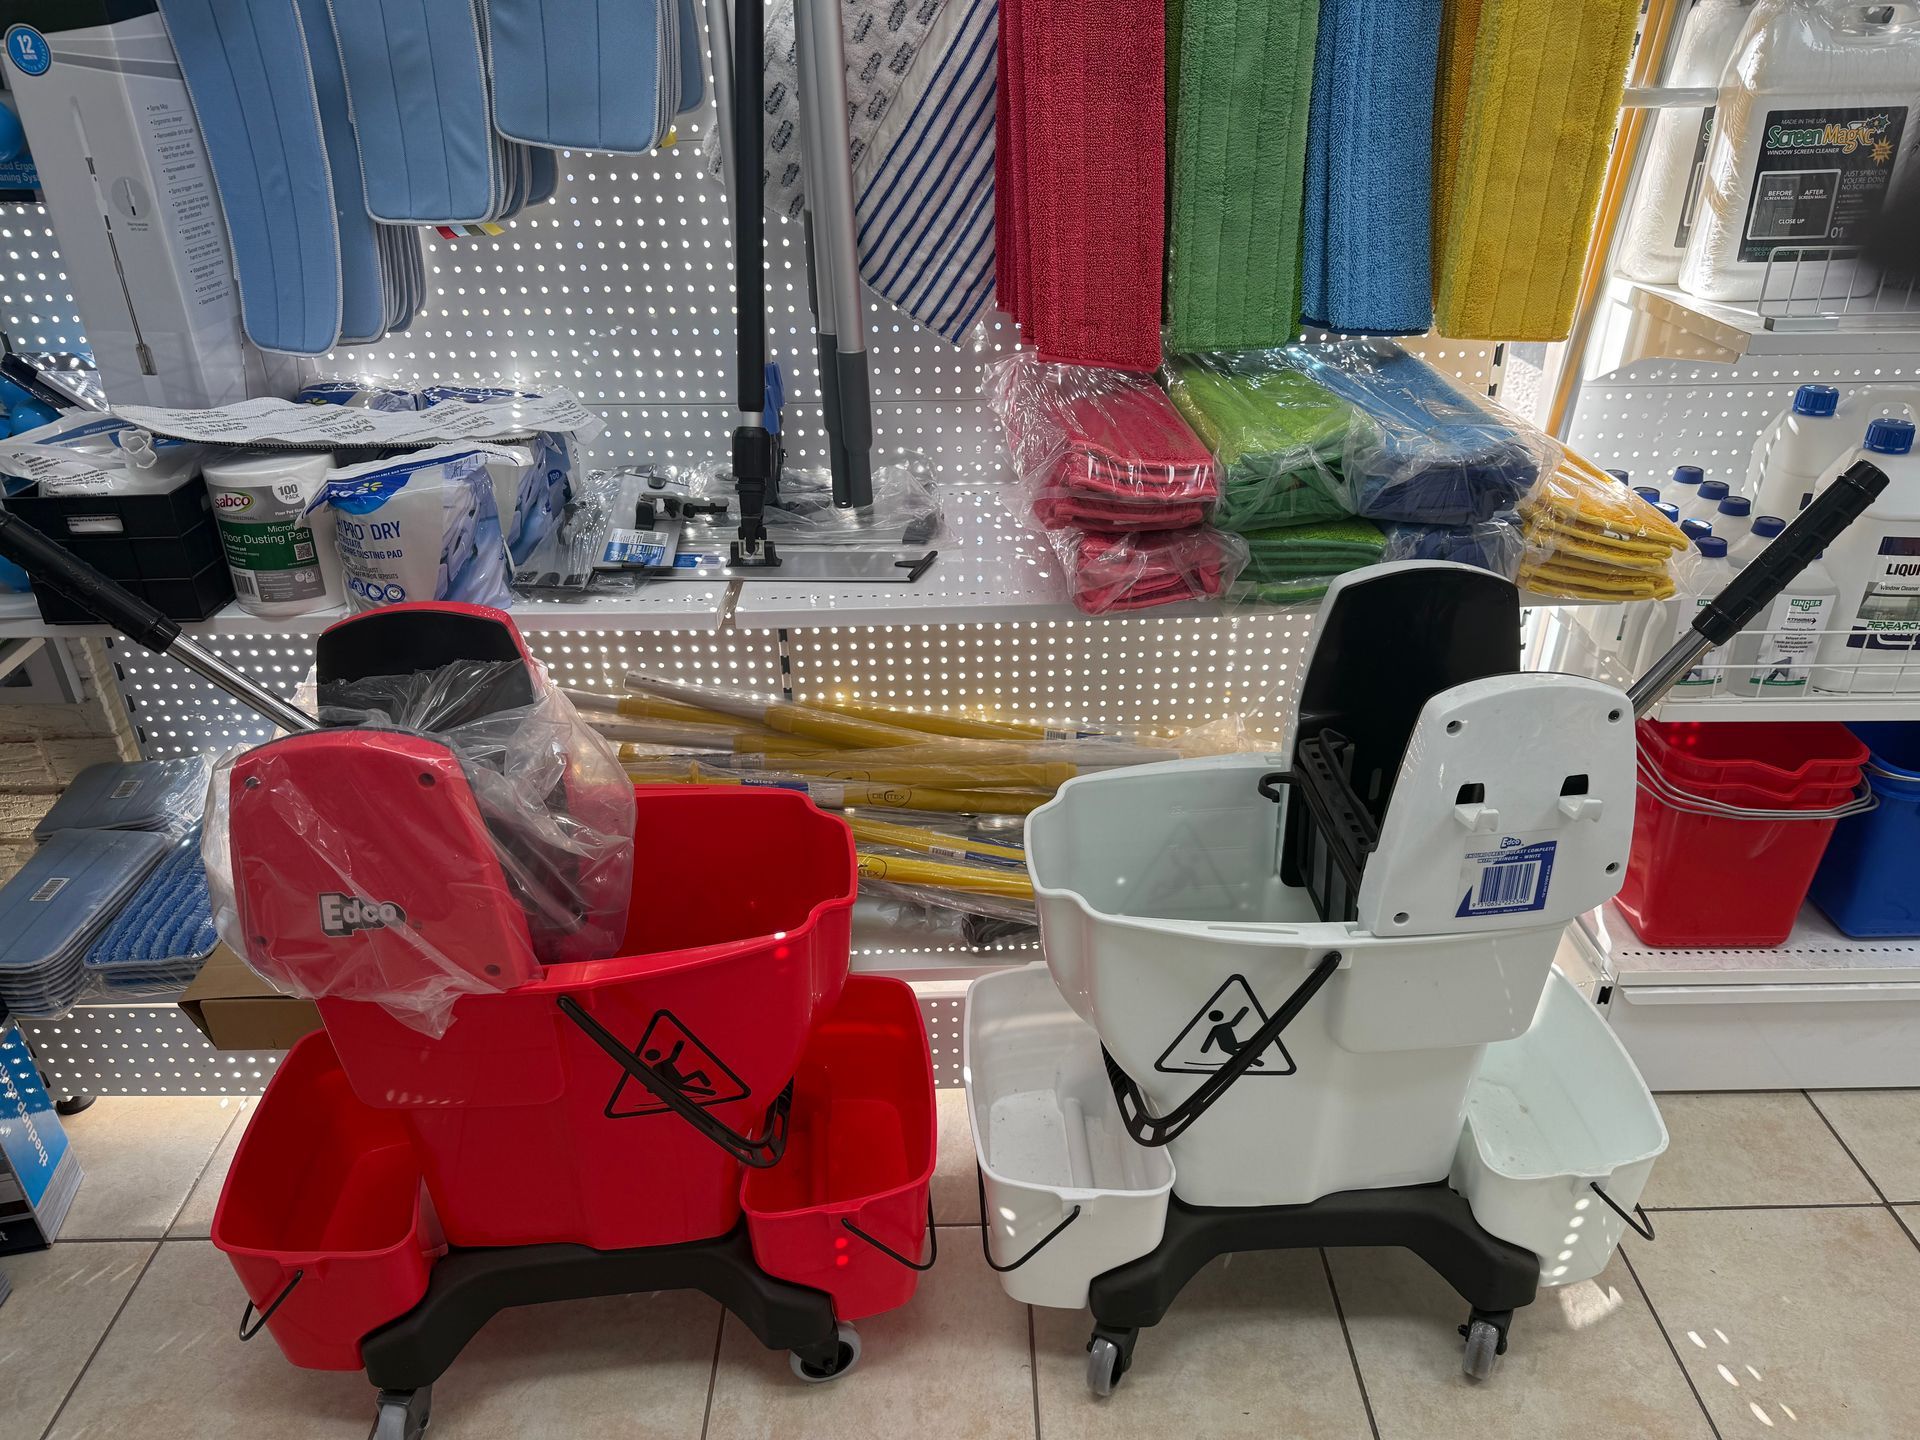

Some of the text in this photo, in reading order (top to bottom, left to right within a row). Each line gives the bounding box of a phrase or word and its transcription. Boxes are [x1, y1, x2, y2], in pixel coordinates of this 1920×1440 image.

[17, 35, 35, 53] 12
[1843, 170, 1859, 178] JUST
[1860, 169, 1877, 177] SPRAY
[1767, 189, 1793, 197] BEFORE
[549, 472, 560, 480] 100
[278, 483, 298, 496] 100
[215, 493, 251, 508] sabco
[267, 523, 297, 533] Microf
[369, 520, 401, 541] DRY
[222, 530, 310, 545] Floor Dusting Pad
[386, 549, 403, 560] PAD
[1886, 563, 1920, 578] LIQUI
[1792, 599, 1822, 611] UNGER
[1500, 837, 1522, 849] Edco
[1527, 846, 1555, 854] COMPLETE
[320, 894, 400, 932] Edco
